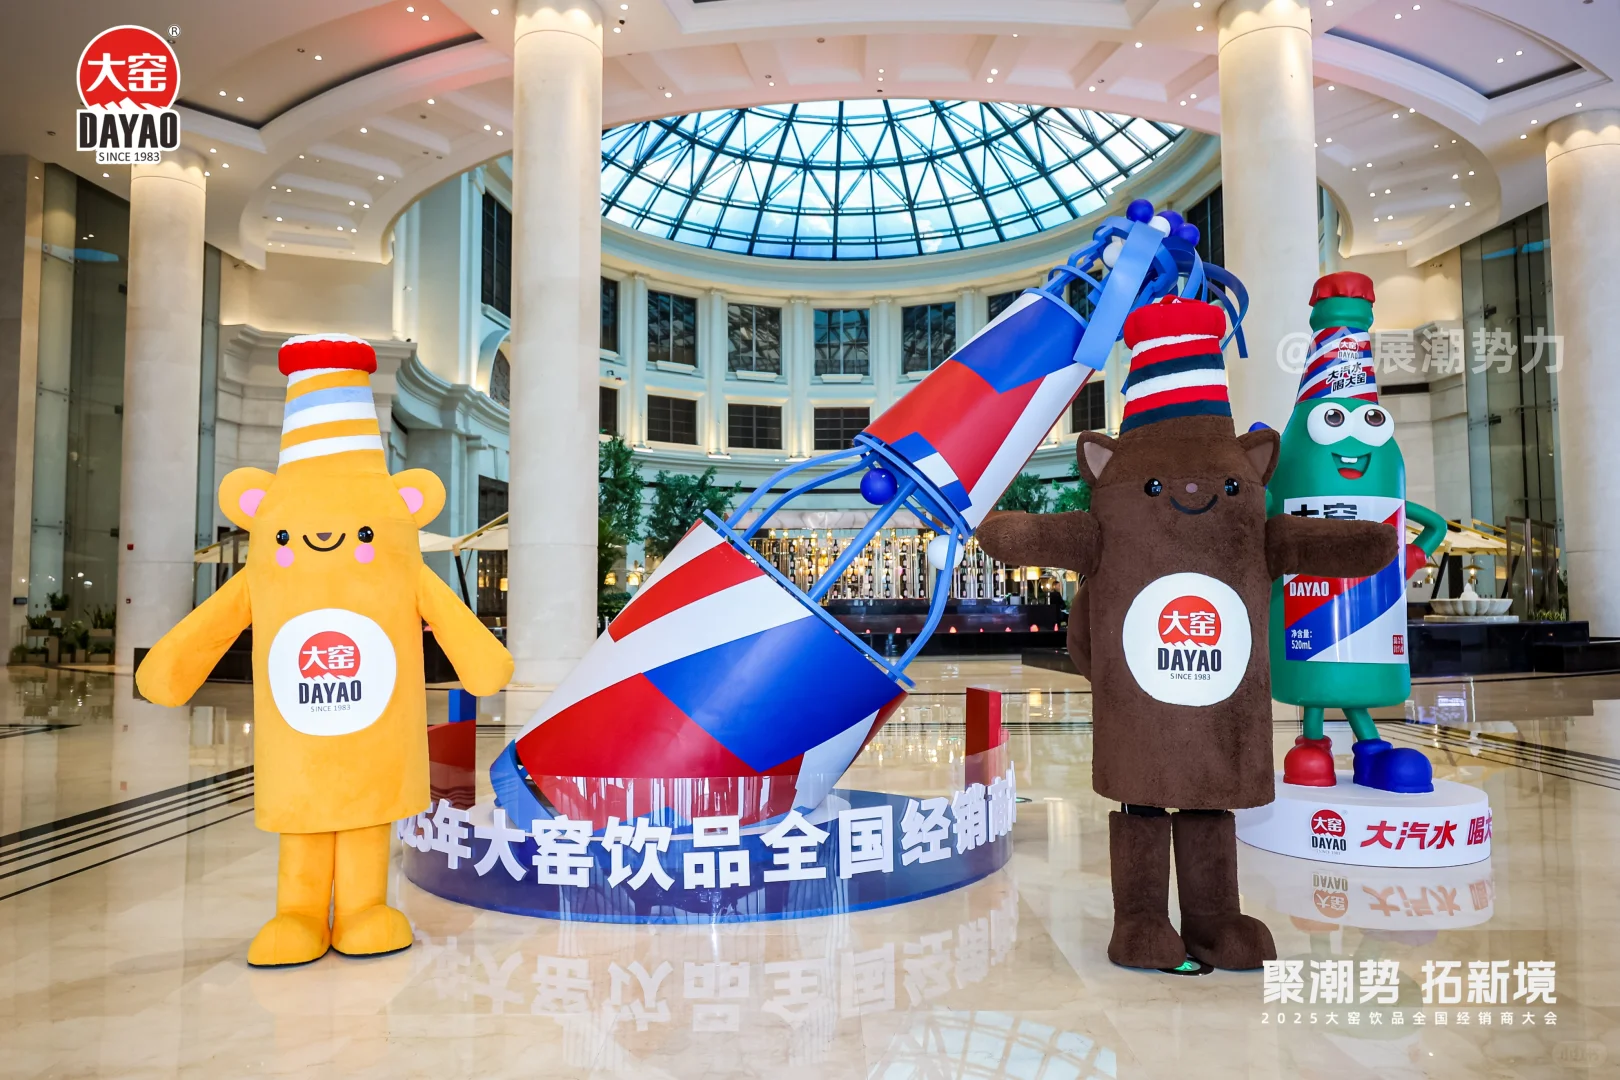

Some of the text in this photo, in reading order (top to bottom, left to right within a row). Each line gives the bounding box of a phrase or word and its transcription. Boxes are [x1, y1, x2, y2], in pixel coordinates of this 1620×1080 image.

[1327, 362, 1361, 383] 大汽水
[1333, 373, 1366, 392] 喝大窑
[1289, 581, 1330, 597] DAYAO
[1162, 610, 1215, 636] 大窑
[301, 645, 354, 671] 大窑
[1157, 647, 1222, 672] DAYAO
[298, 680, 362, 705] DAYAO
[310, 704, 351, 713] SINCE 1983
[1313, 816, 1342, 832] 大窑
[1311, 835, 1347, 852] DAYAO
[1360, 820, 1458, 850] 大汽水
